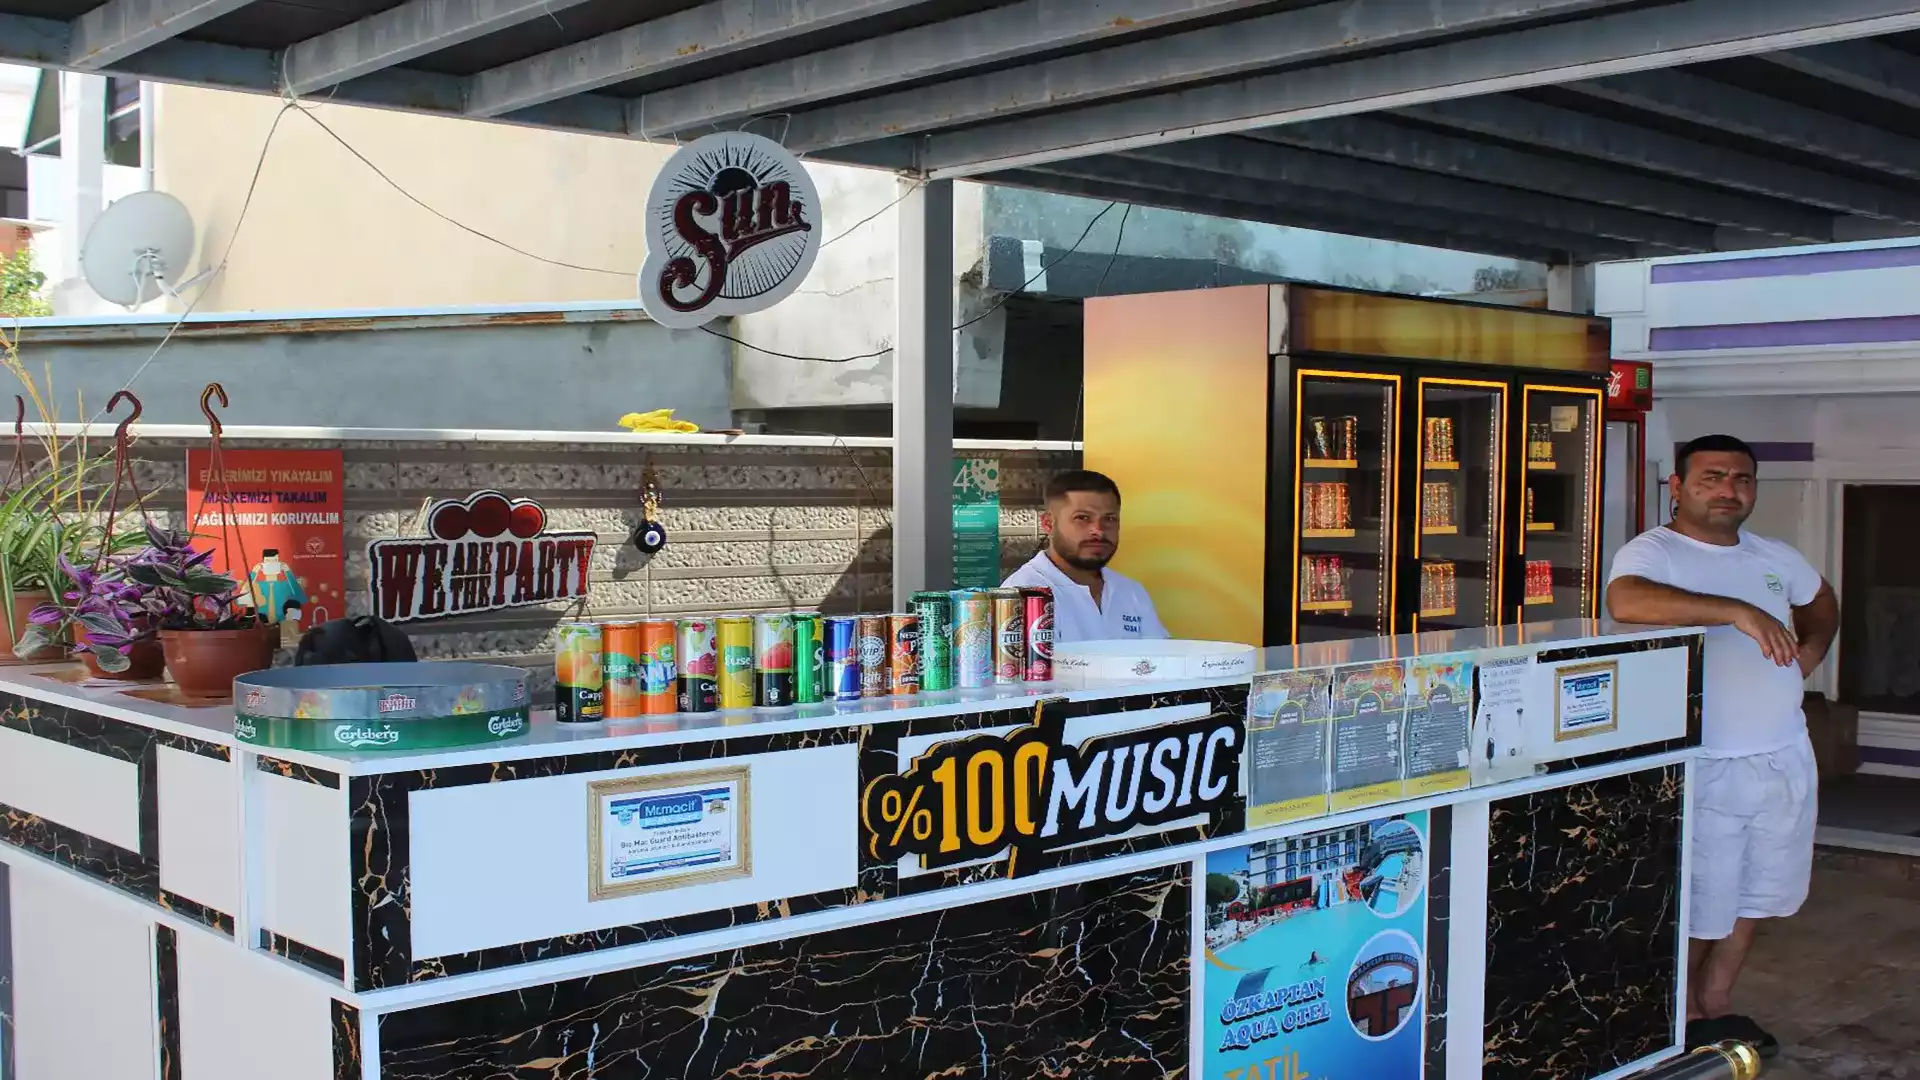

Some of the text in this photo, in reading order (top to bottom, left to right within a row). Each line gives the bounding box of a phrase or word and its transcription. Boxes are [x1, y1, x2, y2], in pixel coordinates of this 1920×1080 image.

[658, 180, 811, 312] Sun
[271, 470, 333, 483] YIKAYALIM
[276, 491, 327, 504] TAKALIM
[271, 512, 339, 525] KORUYALIM
[379, 539, 594, 619] WE ARE THE PARTY
[334, 724, 399, 746] Carlsberg
[488, 714, 524, 736] Carlsberg
[881, 741, 1049, 853] %100
[1040, 725, 1236, 838] MUSIC
[1221, 976, 1326, 1022] ÖZKAPTAN
[1220, 1001, 1331, 1050] AQUA OTEL
